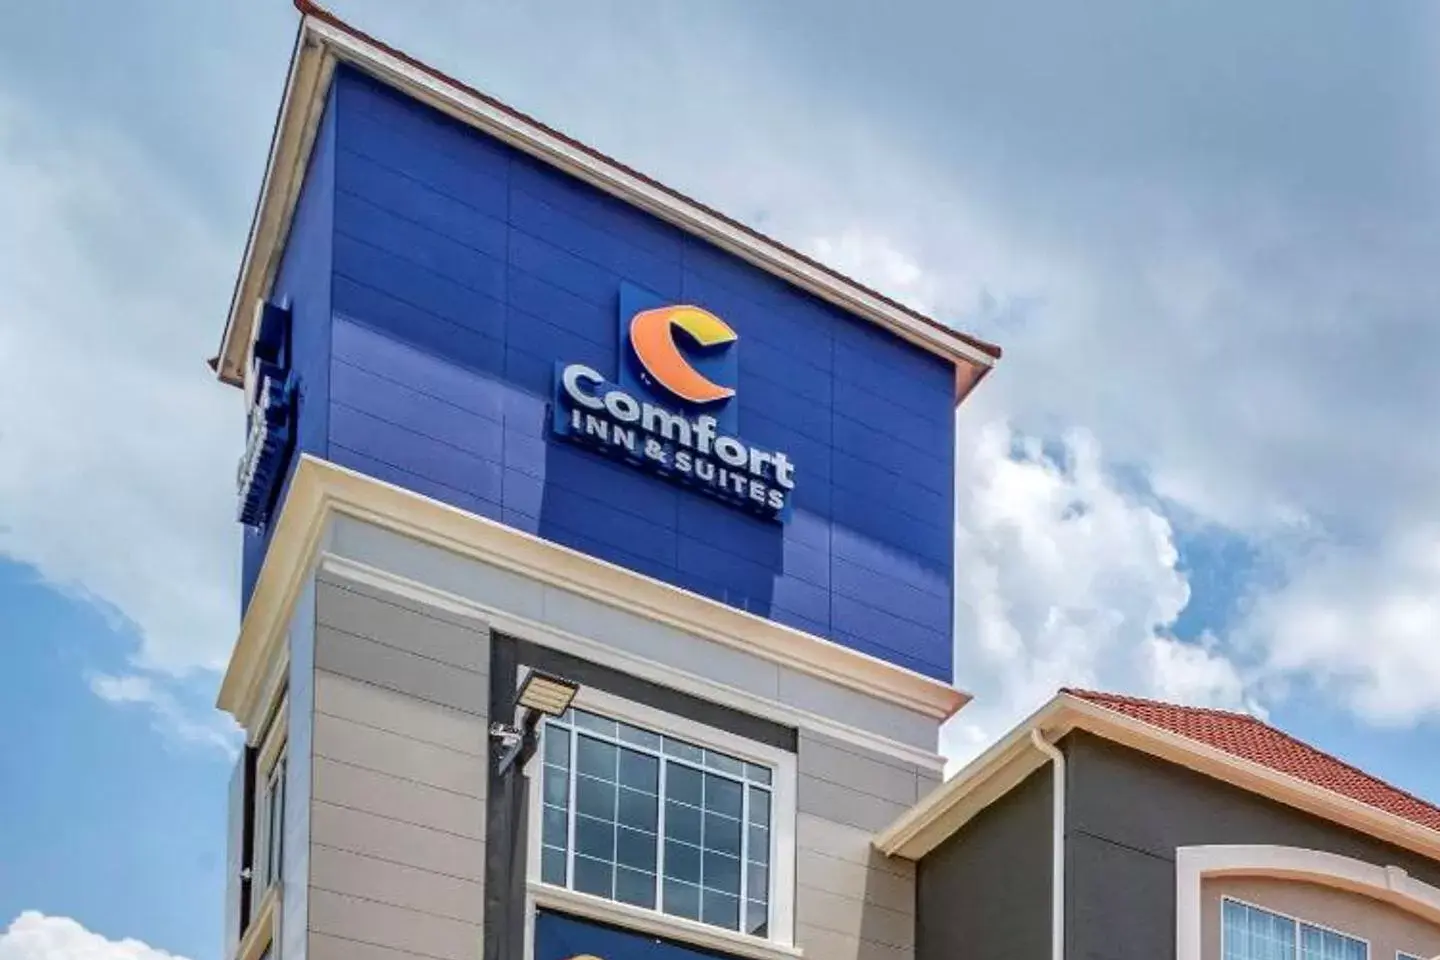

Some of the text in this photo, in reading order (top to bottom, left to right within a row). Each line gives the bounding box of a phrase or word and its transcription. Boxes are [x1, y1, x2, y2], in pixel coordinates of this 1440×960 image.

[562, 363, 796, 489] Comfort
[571, 408, 785, 511] INN & SUITES
